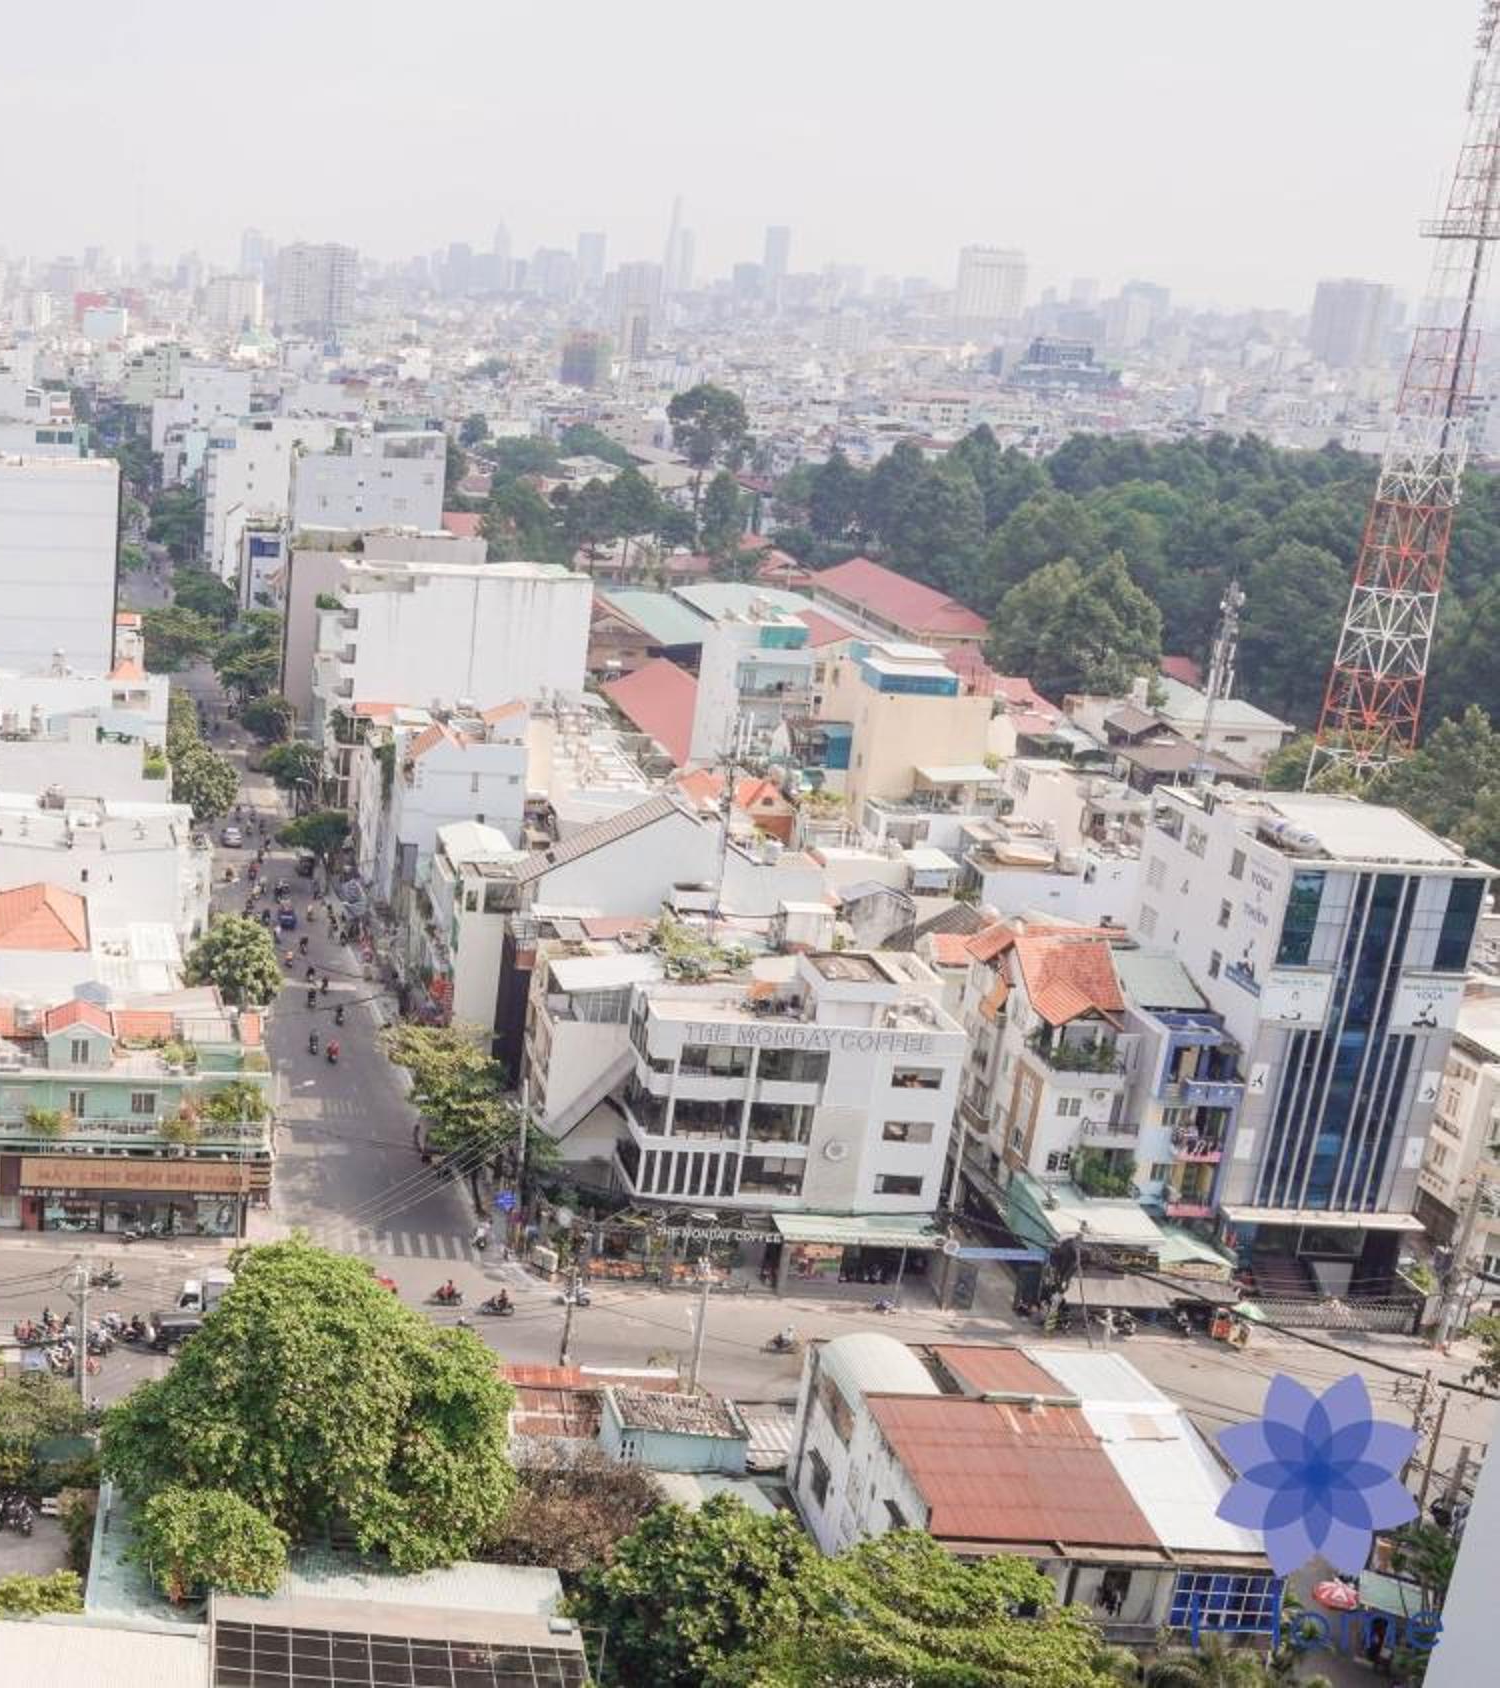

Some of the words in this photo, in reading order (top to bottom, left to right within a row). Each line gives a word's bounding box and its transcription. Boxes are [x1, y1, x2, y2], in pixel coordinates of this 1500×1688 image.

[1416, 991, 1444, 1000] YOGA
[685, 1022, 731, 1043] THE
[737, 1023, 836, 1050] MONDAY
[840, 1030, 933, 1054] COFFEE
[656, 1226, 680, 1238] THE
[681, 1227, 731, 1242] MONDAY
[736, 1231, 782, 1244] COFFEE
